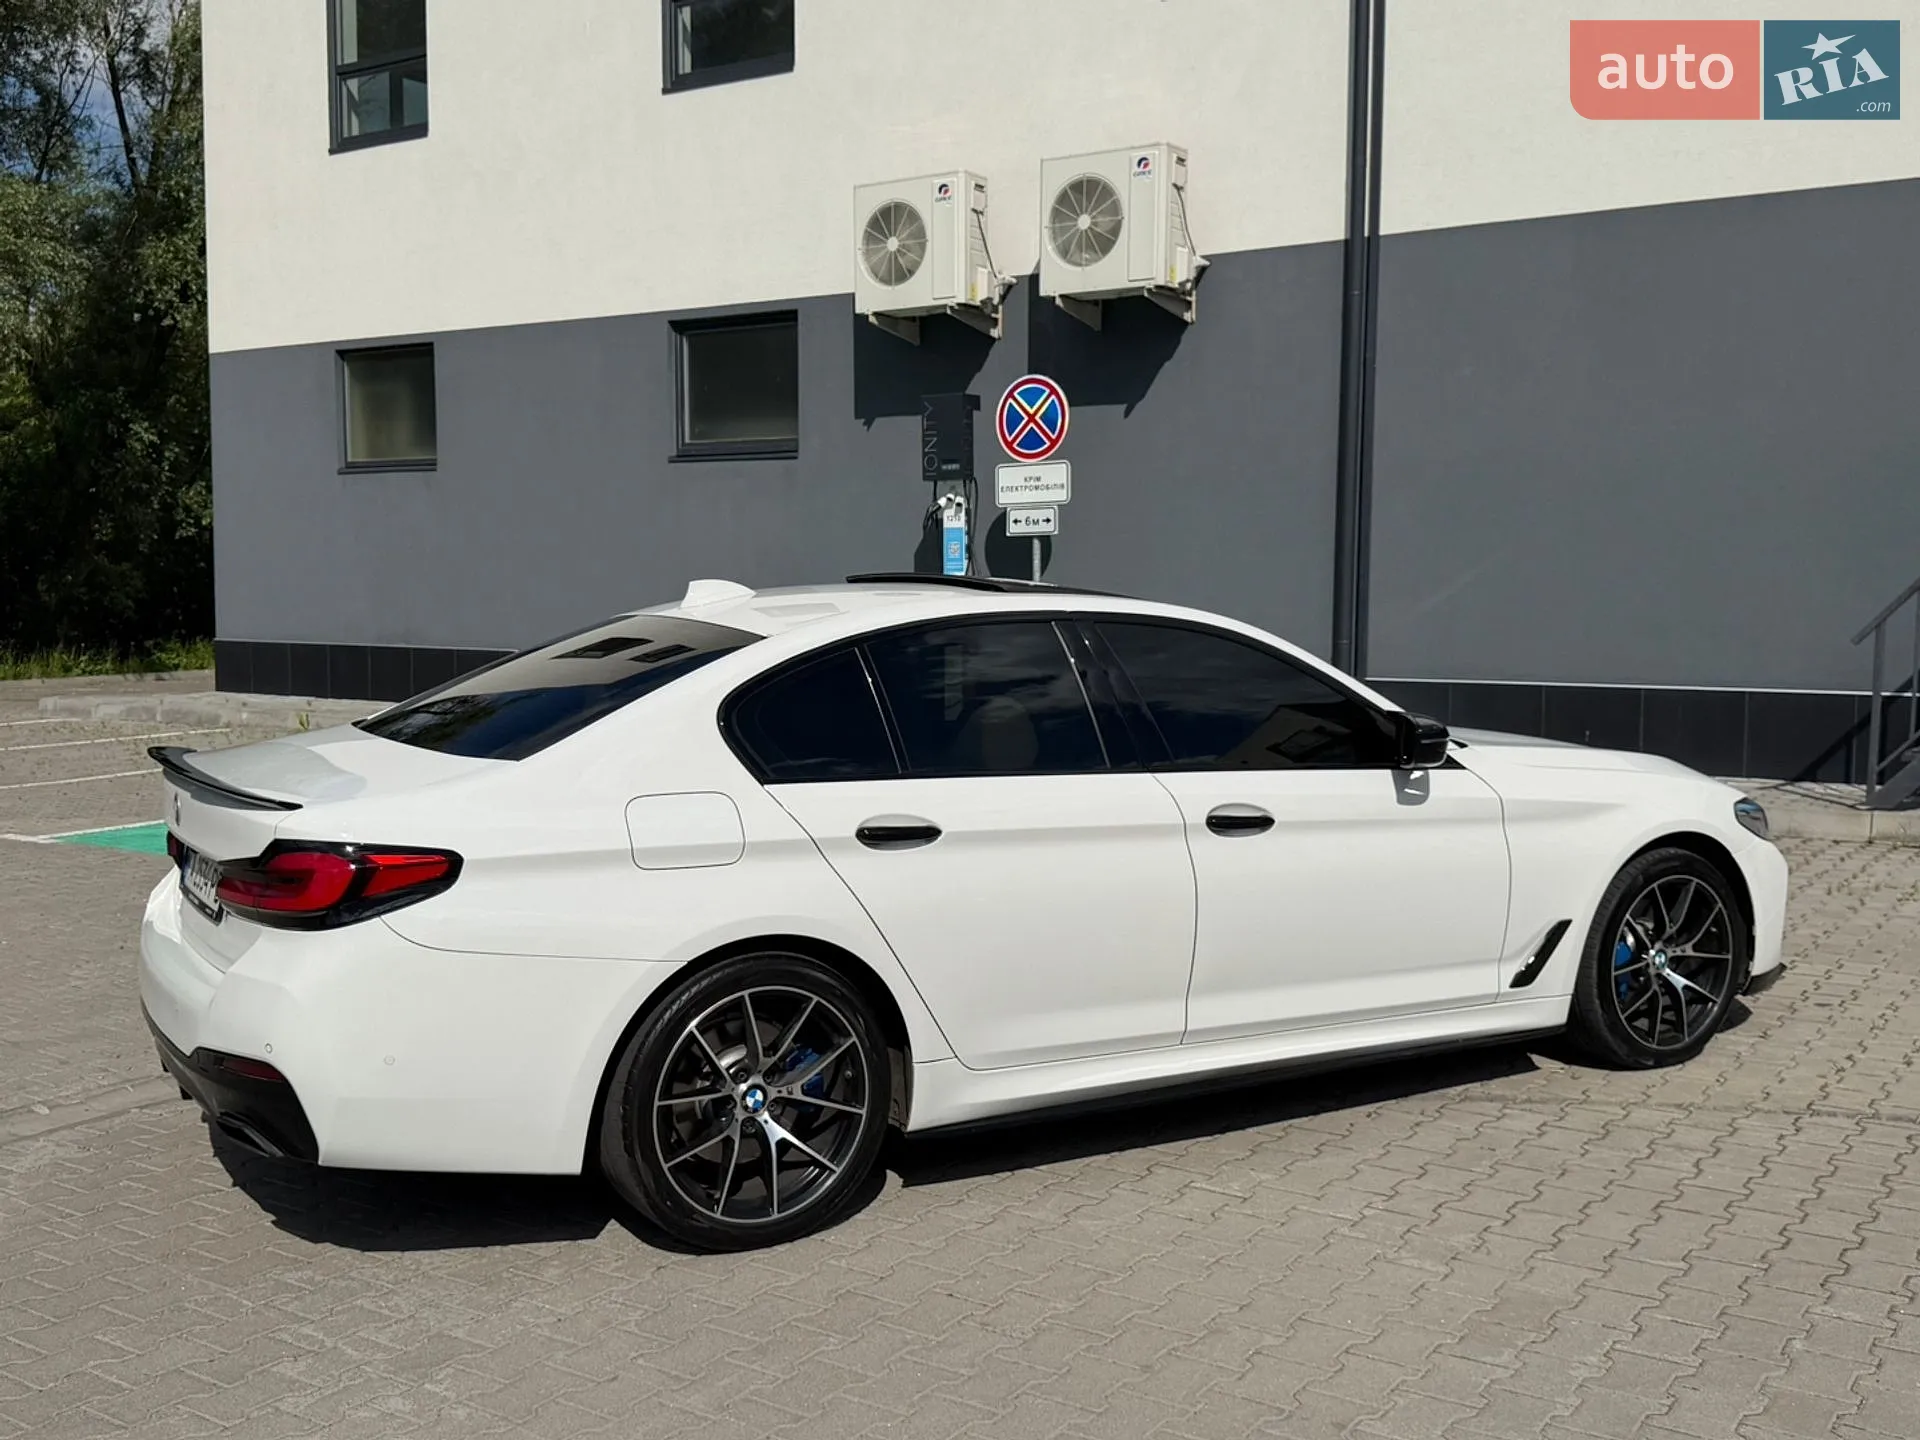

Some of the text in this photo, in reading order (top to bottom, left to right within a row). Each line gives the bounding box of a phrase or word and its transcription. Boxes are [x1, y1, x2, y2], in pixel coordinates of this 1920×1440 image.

[923, 401, 938, 476] IONITY
[1023, 475, 1042, 483] КРІМ
[1000, 483, 1065, 493] ЕЛЕКТРОМОБІЛІВ
